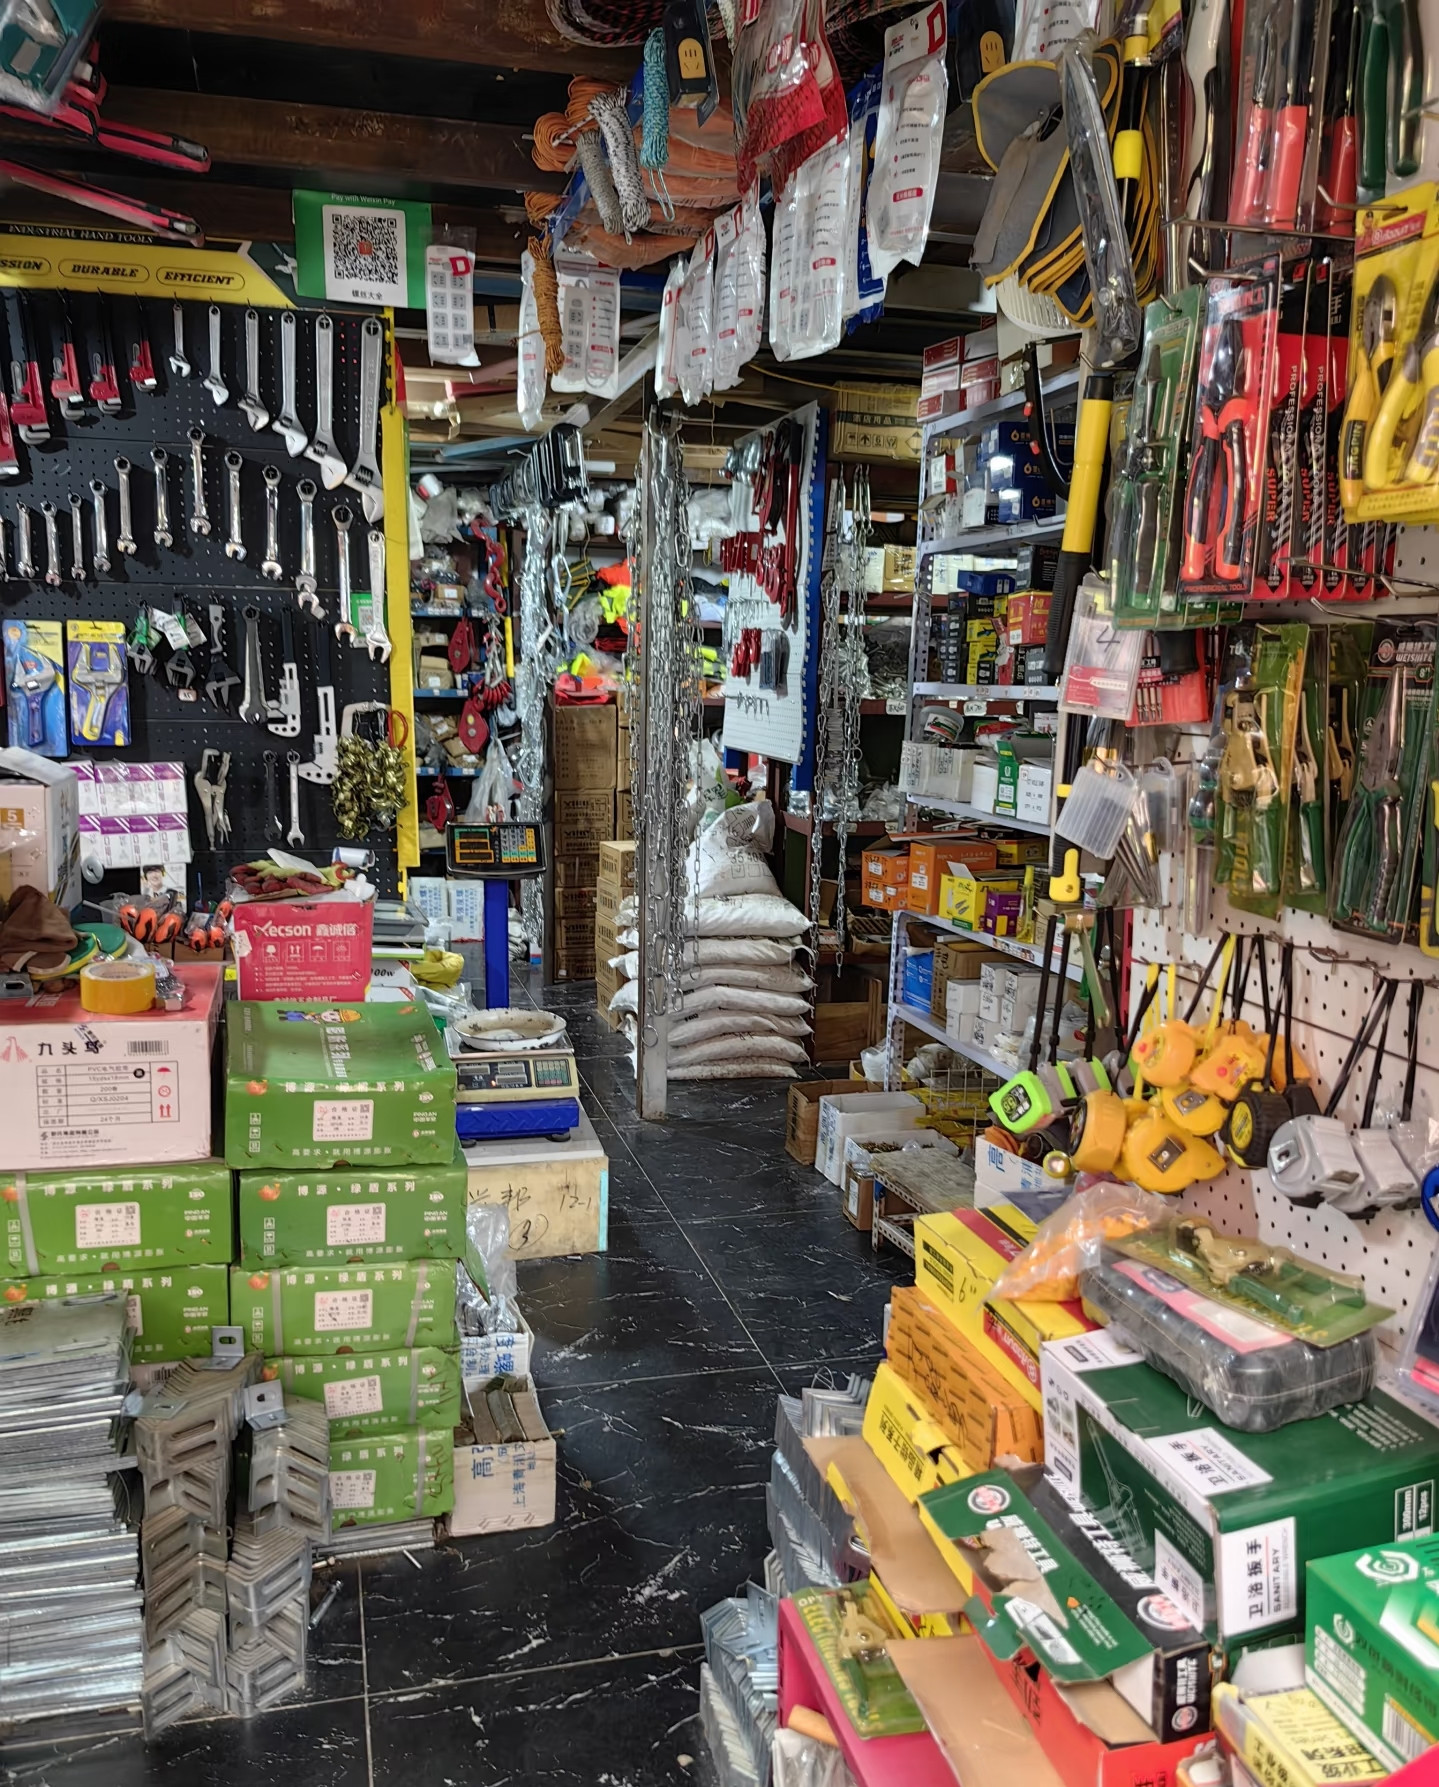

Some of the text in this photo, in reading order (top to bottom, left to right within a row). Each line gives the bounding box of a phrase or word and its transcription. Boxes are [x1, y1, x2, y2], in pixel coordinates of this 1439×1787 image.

[331, 194, 344, 202] Pay
[345, 194, 359, 202] with
[383, 197, 395, 205] Pay
[9, 224, 154, 244] INDUSTRIAL HAND TOOLS
[71, 264, 139, 279] DURABLE
[164, 271, 235, 286] EFFICIENT
[7, 809, 17, 823] 5
[1246, 1538, 1263, 1618] 卫浴扳手
